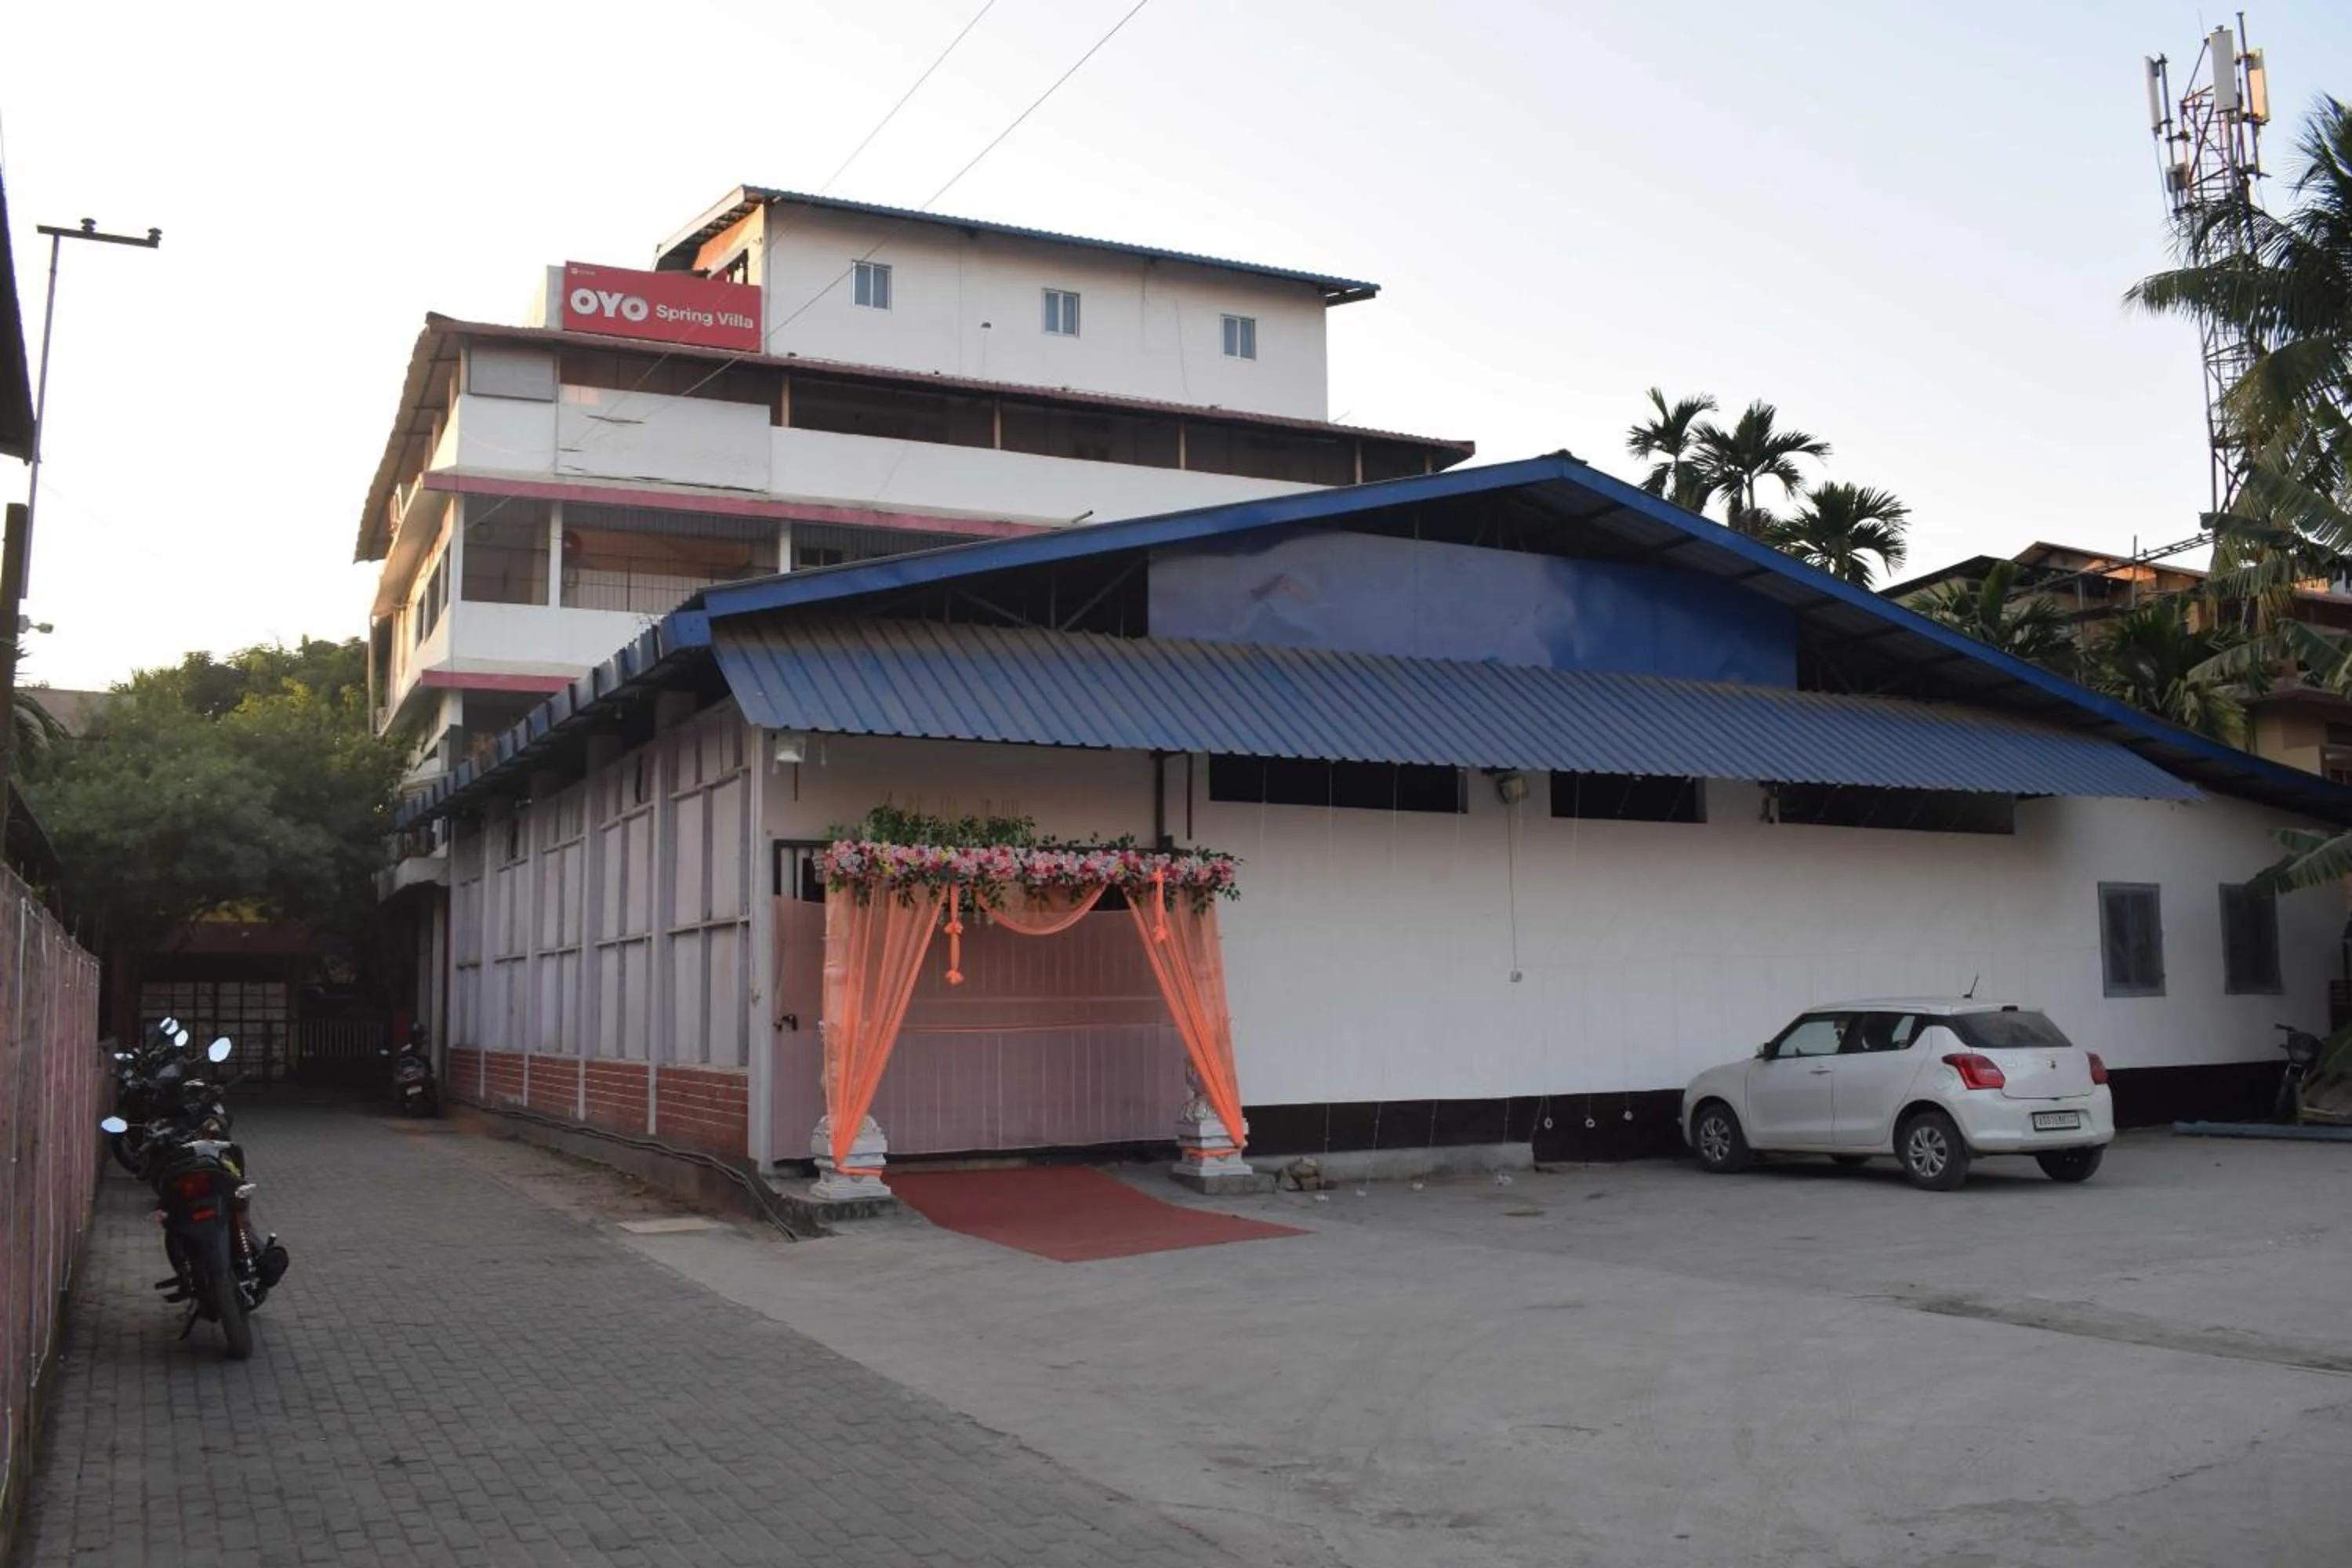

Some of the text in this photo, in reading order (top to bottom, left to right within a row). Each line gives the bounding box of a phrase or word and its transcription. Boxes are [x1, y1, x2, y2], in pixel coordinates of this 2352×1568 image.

[570, 288, 753, 328] OYO Spring Villa
